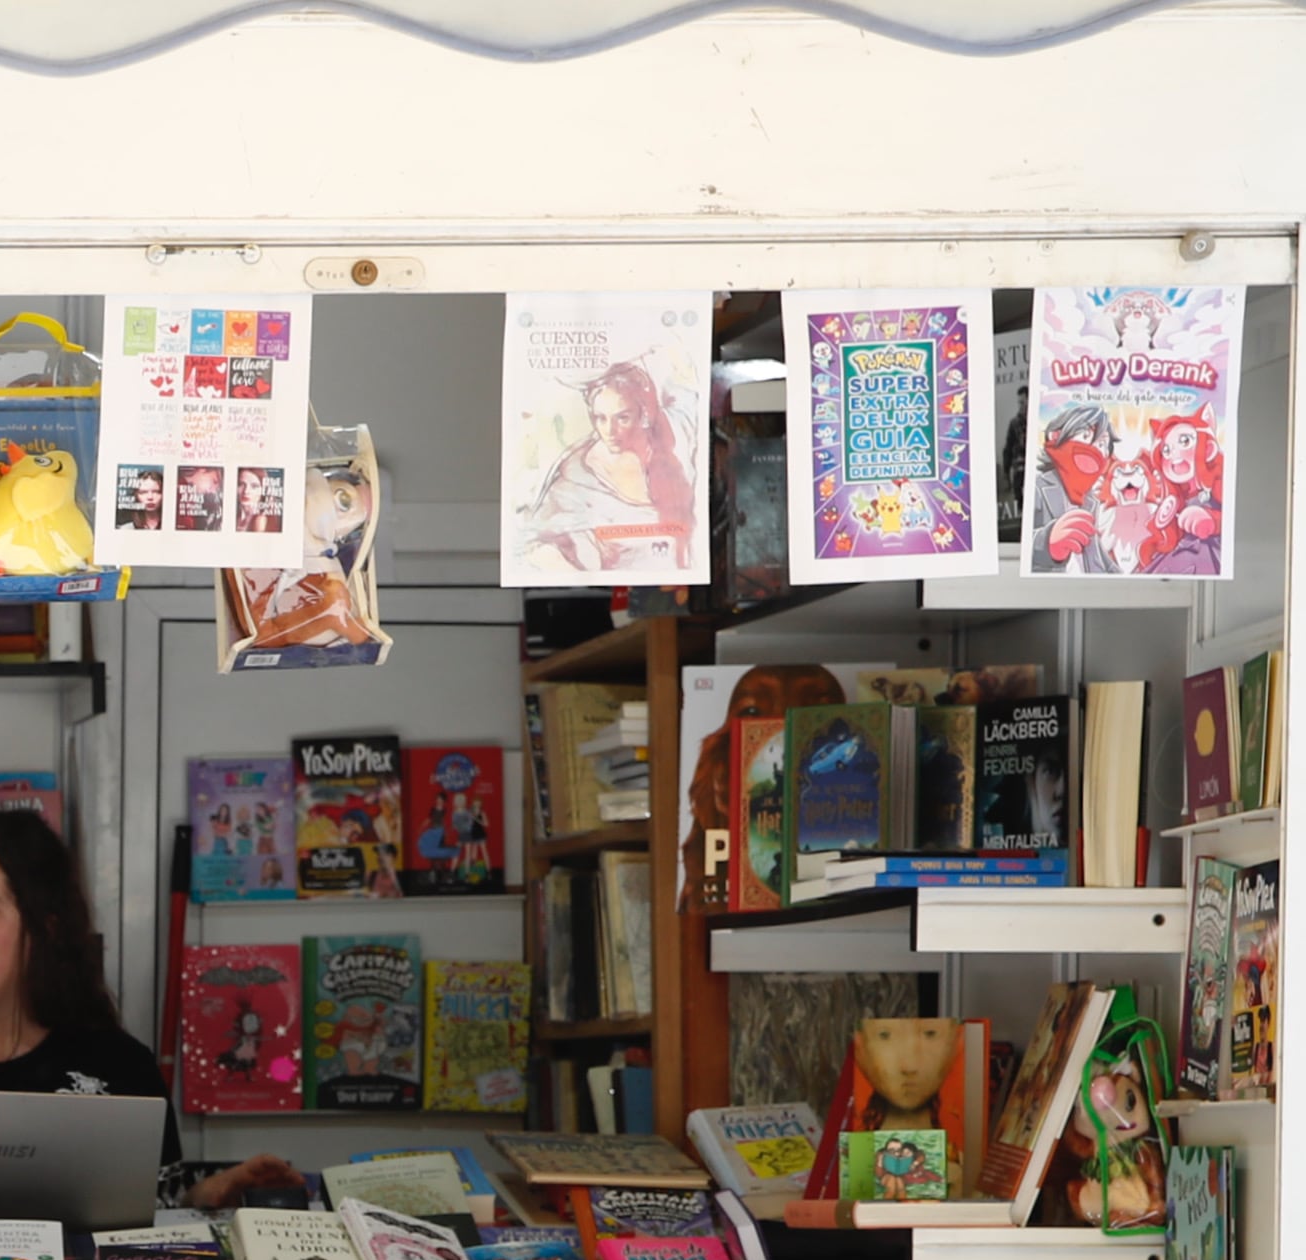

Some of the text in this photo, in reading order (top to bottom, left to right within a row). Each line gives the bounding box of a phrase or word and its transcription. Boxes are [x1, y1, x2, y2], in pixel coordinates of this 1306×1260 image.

[529, 331, 608, 345] CUENTOS
[544, 344, 610, 357] MUJERES
[528, 356, 609, 370] VALIENTES
[855, 348, 925, 374] Pokémon
[1052, 355, 1216, 388] Luly y Derank
[849, 375, 928, 393] SUPER
[849, 393, 929, 410] EXTRA
[850, 410, 929, 429] DELUX
[850, 426, 931, 452] GUÍA
[850, 452, 930, 465] ESENCIAL
[850, 464, 932, 479] DEFINITIVA
[1012, 706, 1058, 722] CAMILLA
[983, 720, 1059, 742] LÄCKBERG
[301, 746, 393, 776] YoSoyPlex
[983, 756, 1035, 776] FEXEUS
[982, 835, 1059, 851] MENTALISTA
